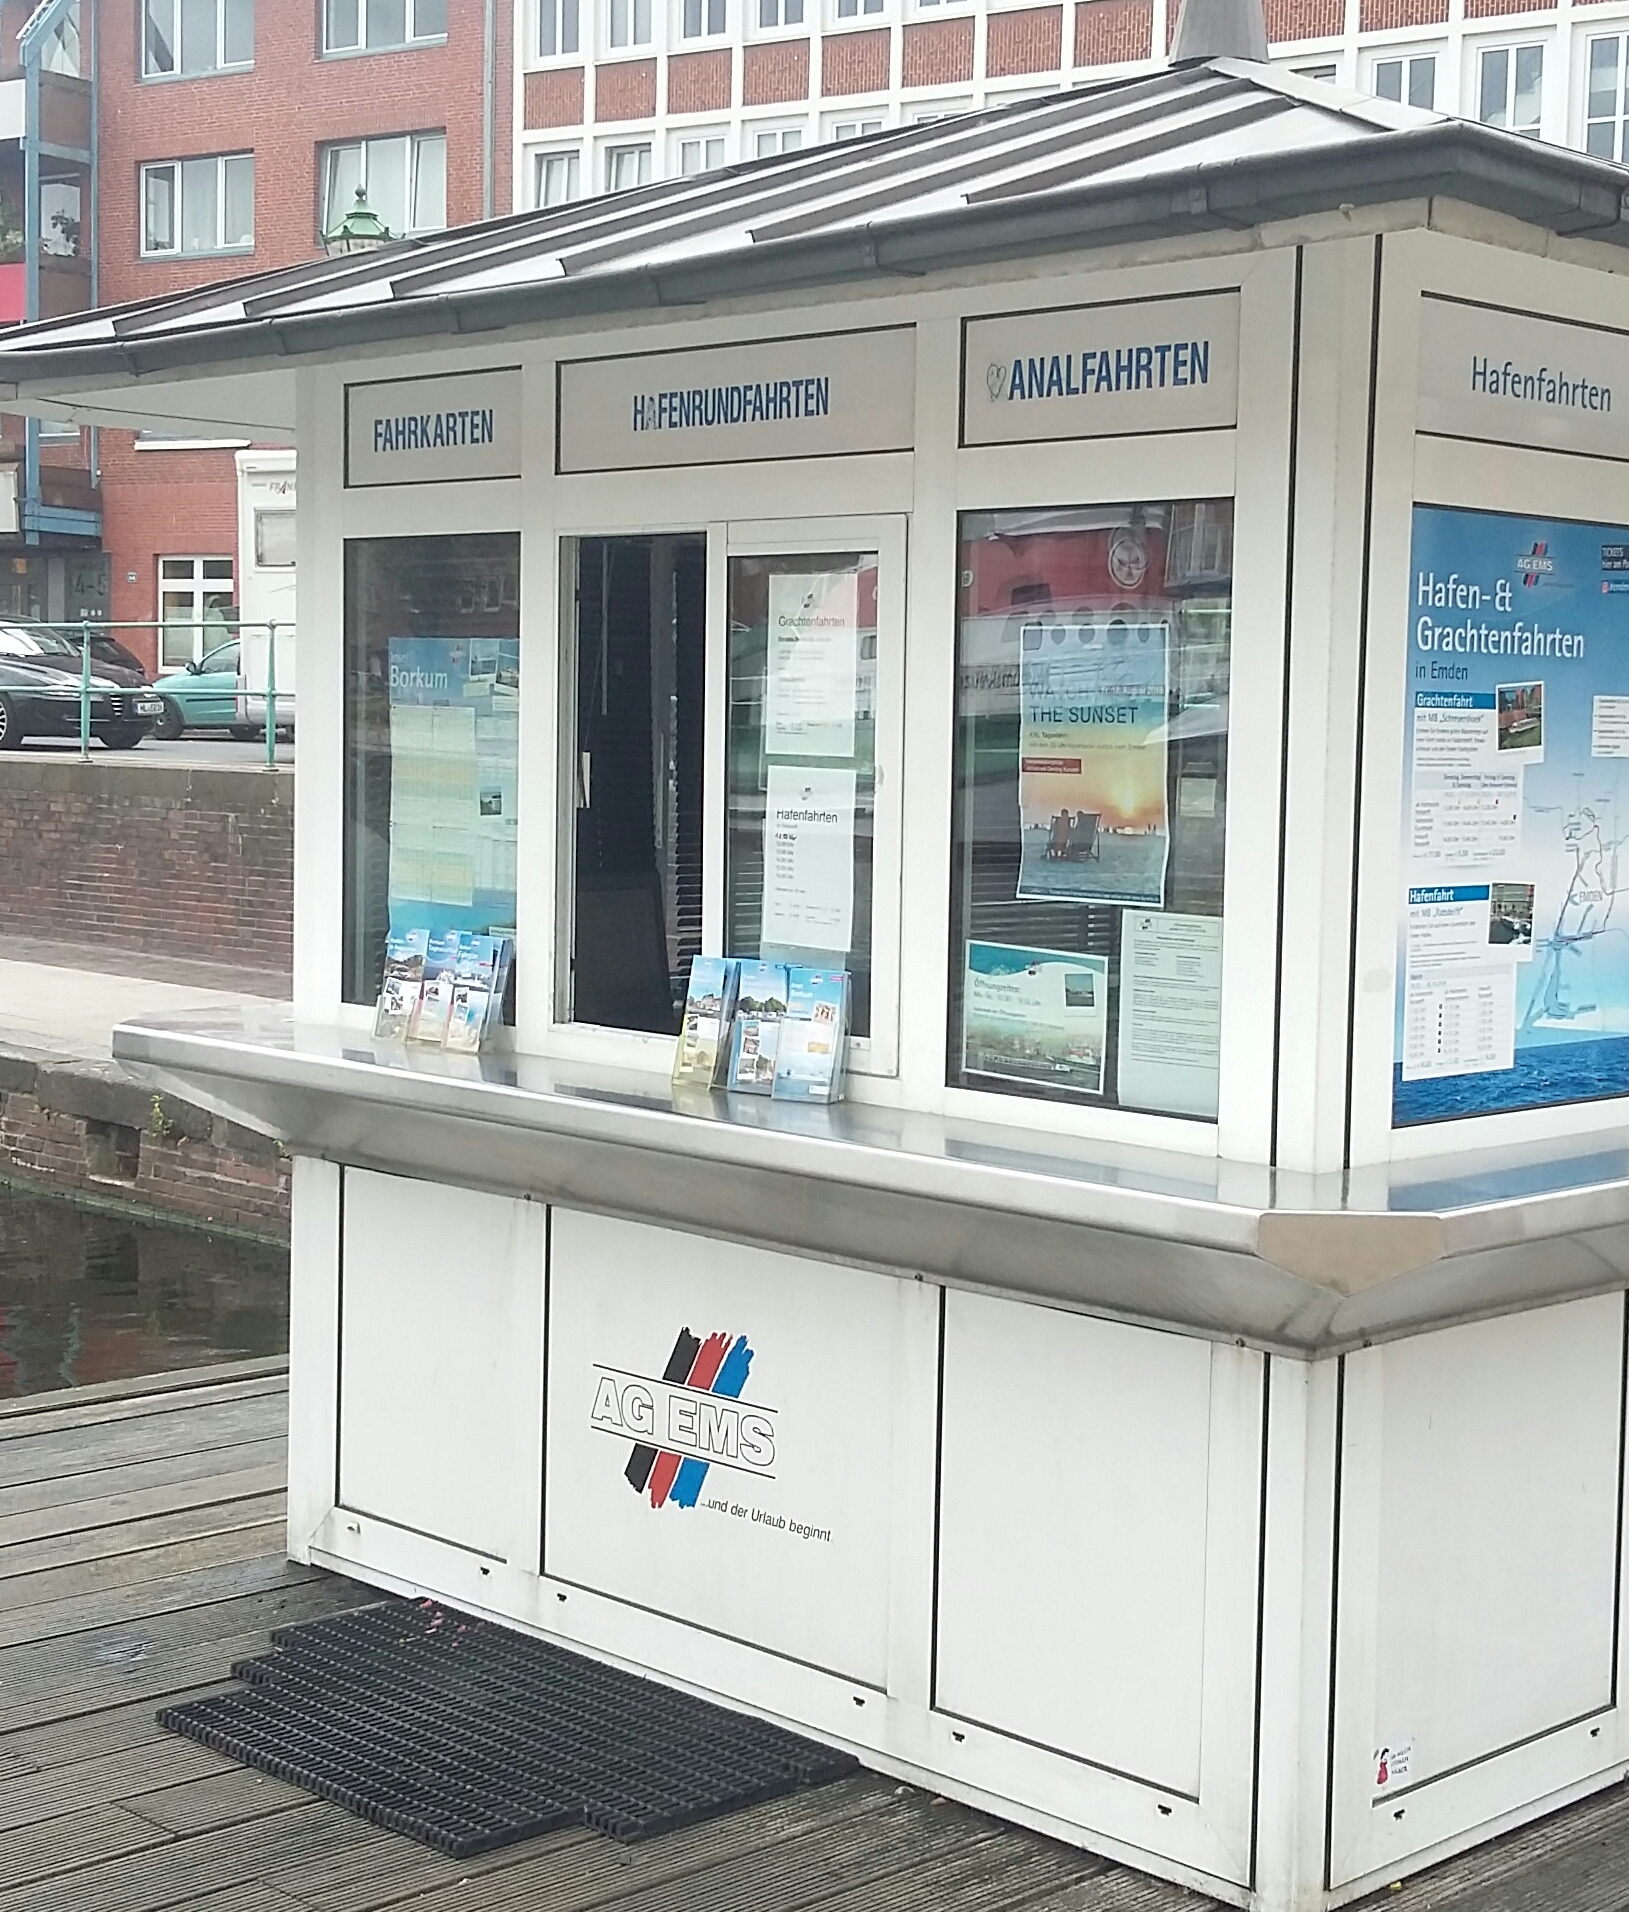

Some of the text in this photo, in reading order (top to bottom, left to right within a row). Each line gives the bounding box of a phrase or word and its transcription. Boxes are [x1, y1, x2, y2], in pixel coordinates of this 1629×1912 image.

[1008, 341, 1209, 400] ANALFAHRTEN
[1471, 356, 1612, 413] Hafenfahrten
[633, 377, 829, 431] HAFENRUNDFAHRTEN
[374, 409, 494, 453] FAHRKARTEN
[1517, 558, 1553, 571] AG EMS
[1418, 571, 1512, 612] Hafen- &
[778, 615, 846, 627] Grachtenfahrten
[1417, 615, 1585, 658] Grachtenfahrten
[390, 665, 448, 689] Borkum
[1415, 661, 1468, 680] in Emden
[1417, 693, 1473, 708] Grachtenfahrt
[1029, 706, 1139, 724] THE SUNSET
[776, 809, 838, 824] Hafenfahrten
[1410, 888, 1455, 902] Hafenfahrt
[591, 1376, 776, 1467] AG EMS
[730, 1503, 748, 1518] der
[750, 1508, 787, 1530] Urlaub
